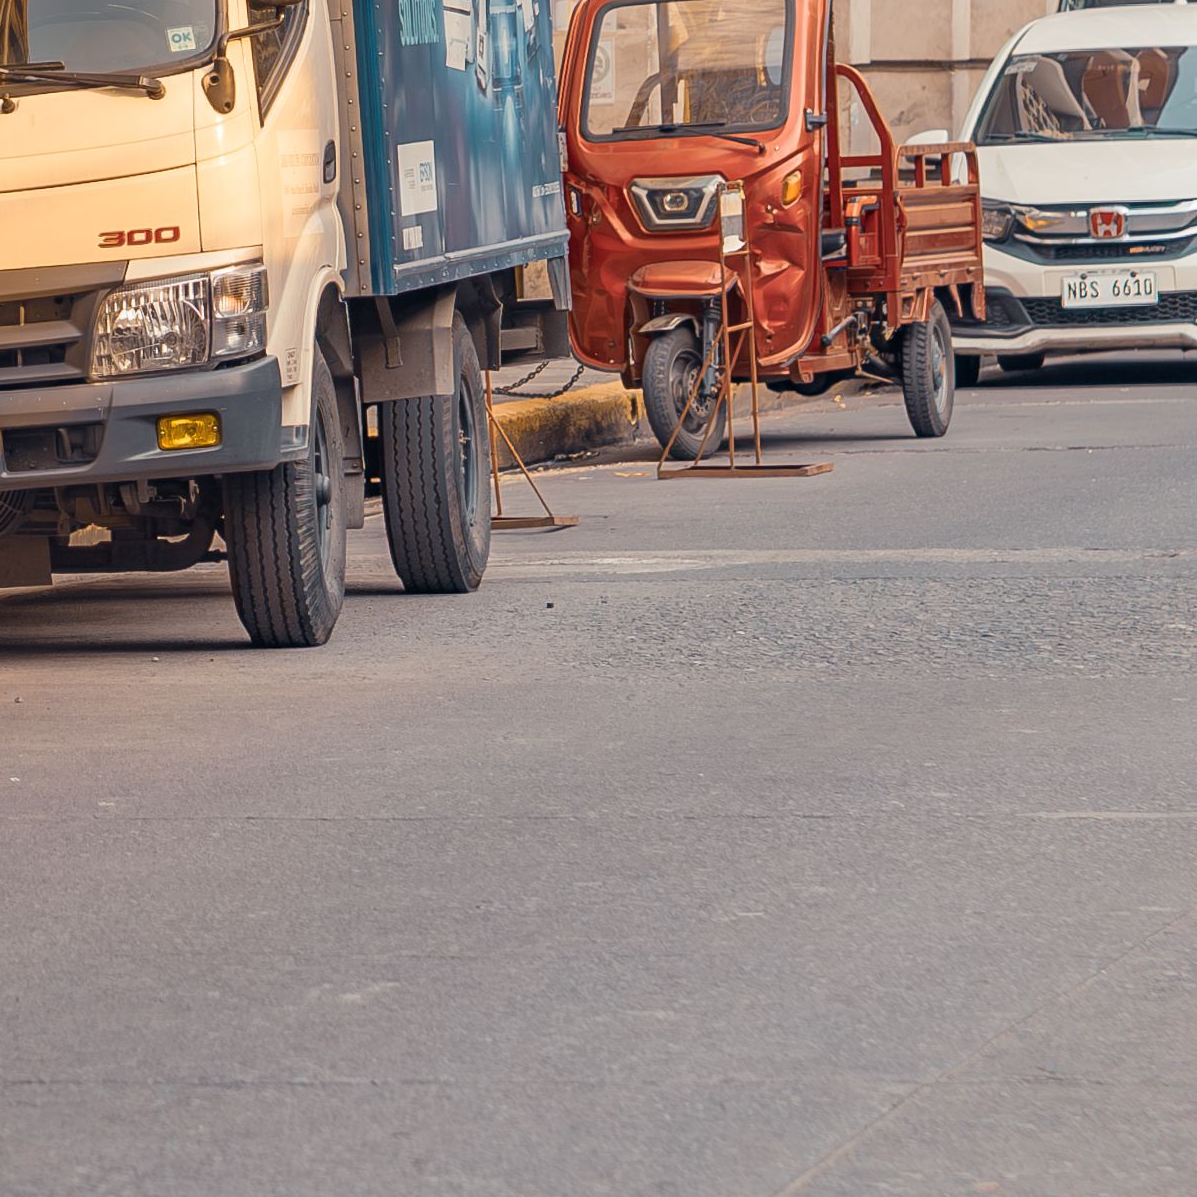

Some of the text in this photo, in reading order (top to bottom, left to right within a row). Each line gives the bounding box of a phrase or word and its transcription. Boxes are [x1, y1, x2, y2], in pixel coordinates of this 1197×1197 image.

[171, 32, 192, 43] OK
[98, 225, 181, 249] 300
[1068, 278, 1153, 300] NBS 6610
